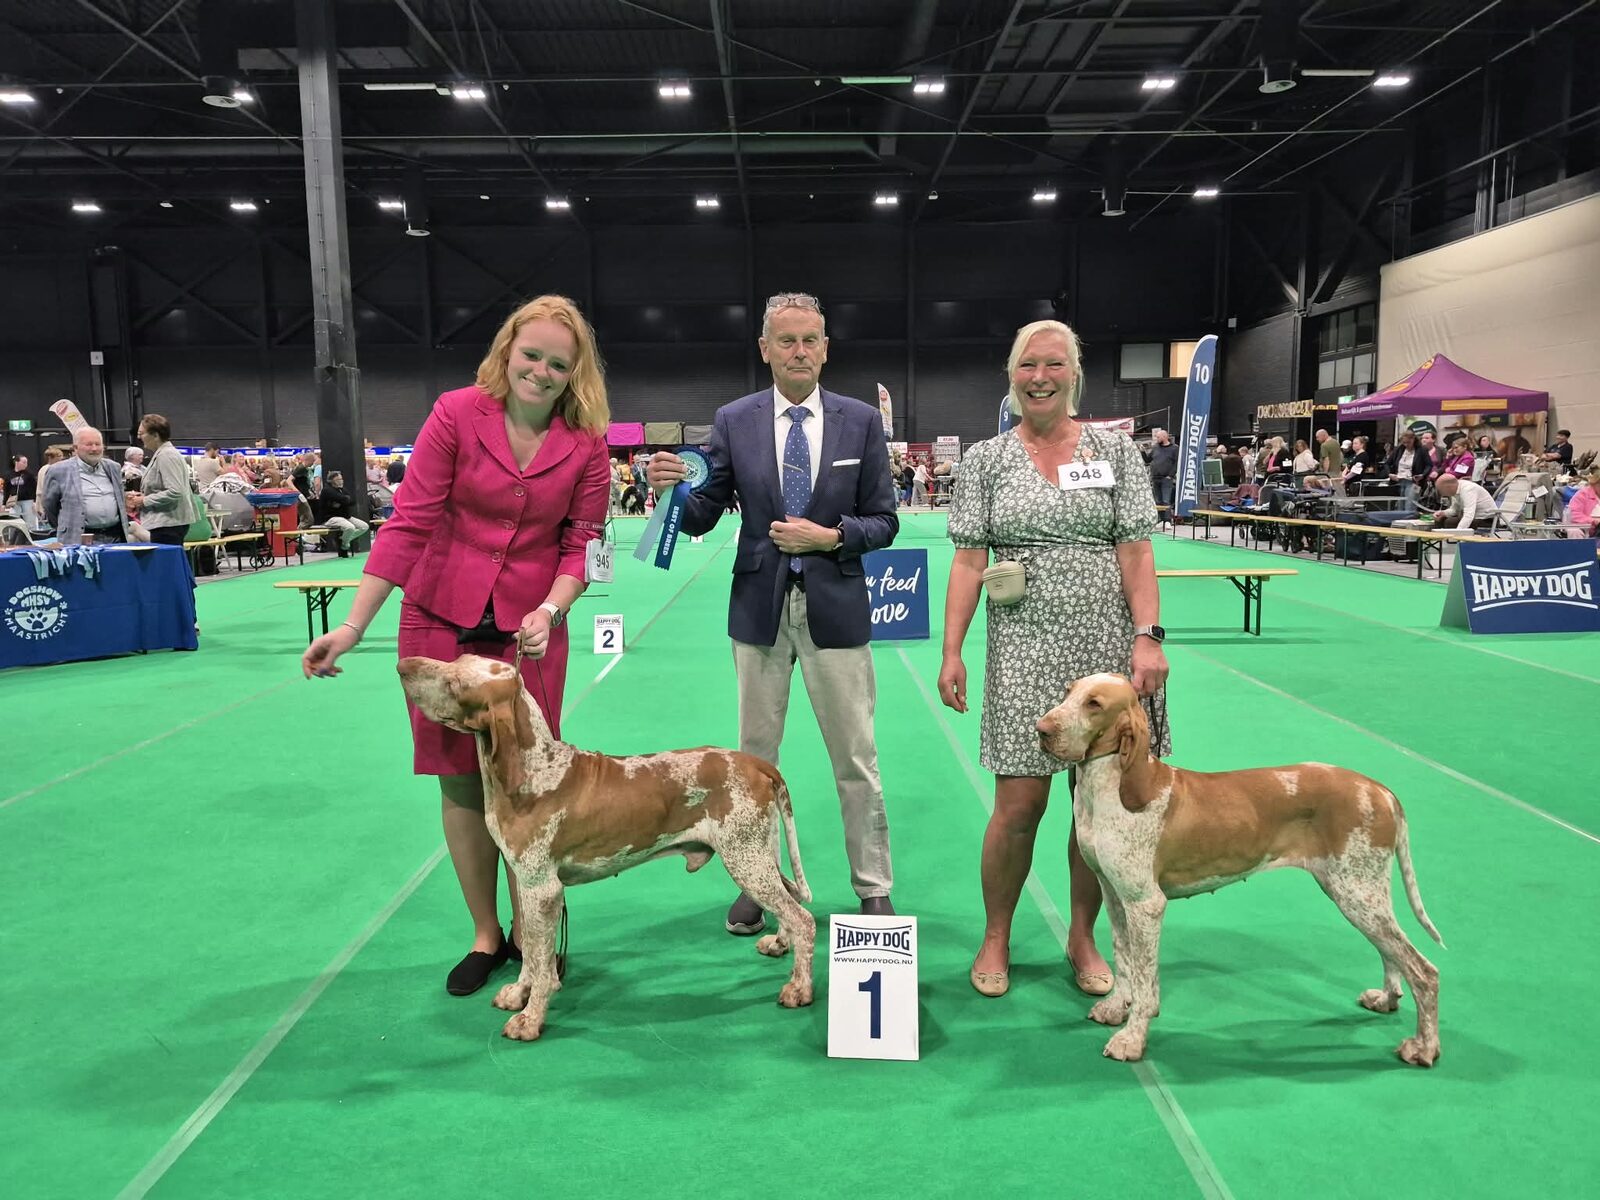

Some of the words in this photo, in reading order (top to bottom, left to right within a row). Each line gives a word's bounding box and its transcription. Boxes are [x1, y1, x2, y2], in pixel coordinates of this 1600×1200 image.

[1194, 362, 1210, 385] 10
[1003, 411, 1009, 422] 9
[1189, 413, 1203, 448] DOG
[1069, 468, 1102, 482] 948
[1183, 450, 1198, 501] HAPPY
[671, 505, 679, 524] BEST
[669, 524, 676, 533] OF
[662, 534, 672, 556] BREED
[595, 553, 610, 570] 945
[879, 566, 921, 597] feed
[1470, 572, 1542, 604] HAPPY
[1545, 570, 1592, 600] DOG
[9, 585, 63, 605] DOGSHOW
[4, 612, 68, 640] MAASTRICHT
[602, 629, 614, 648] 2
[836, 927, 880, 949] HAPPY
[882, 931, 910, 951] DOG
[833, 956, 913, 965] WWW.HAPPYDOG.NU
[858, 971, 882, 1039] 1
